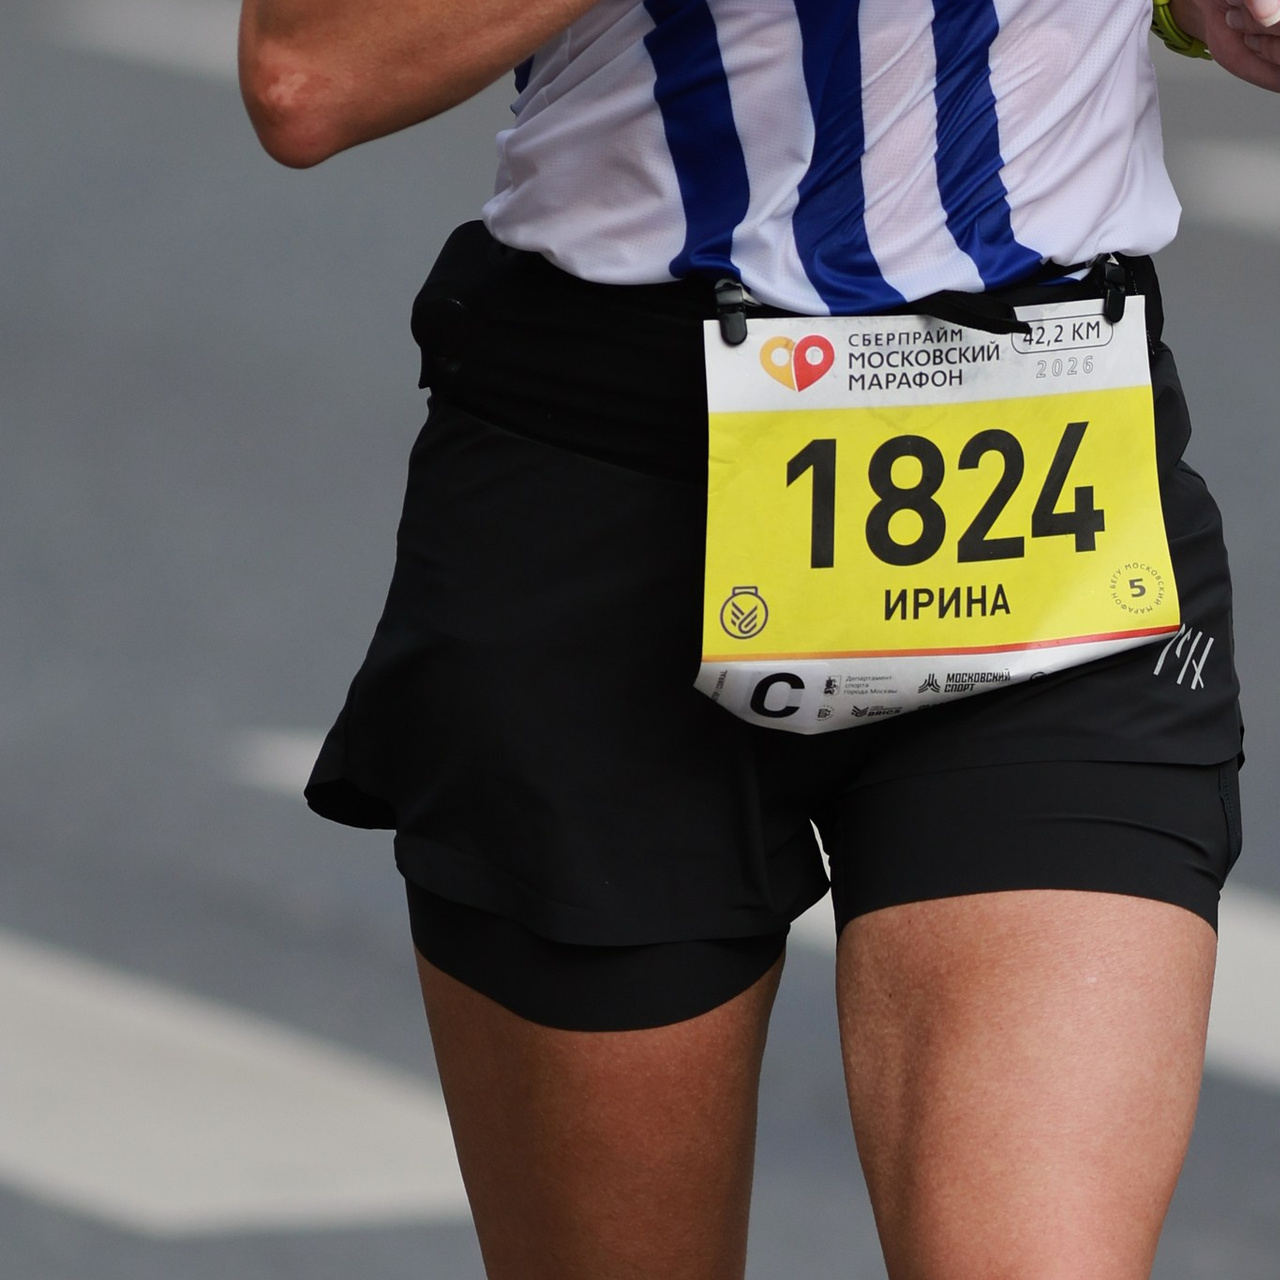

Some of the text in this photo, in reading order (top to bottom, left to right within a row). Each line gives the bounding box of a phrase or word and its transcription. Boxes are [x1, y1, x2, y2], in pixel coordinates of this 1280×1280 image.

[848, 327, 963, 347] СБЕРПРАЙМ
[1023, 324, 1063, 346] 42,2
[848, 340, 1000, 369] МОСКОВСКИЙ
[1036, 355, 1094, 379] 2026
[848, 369, 963, 391] МАРАФОН
[786, 421, 1106, 569] 1824
[1128, 577, 1147, 598] 5
[884, 584, 1011, 620] ИРИНА
[944, 683, 976, 693] СПОРТ
